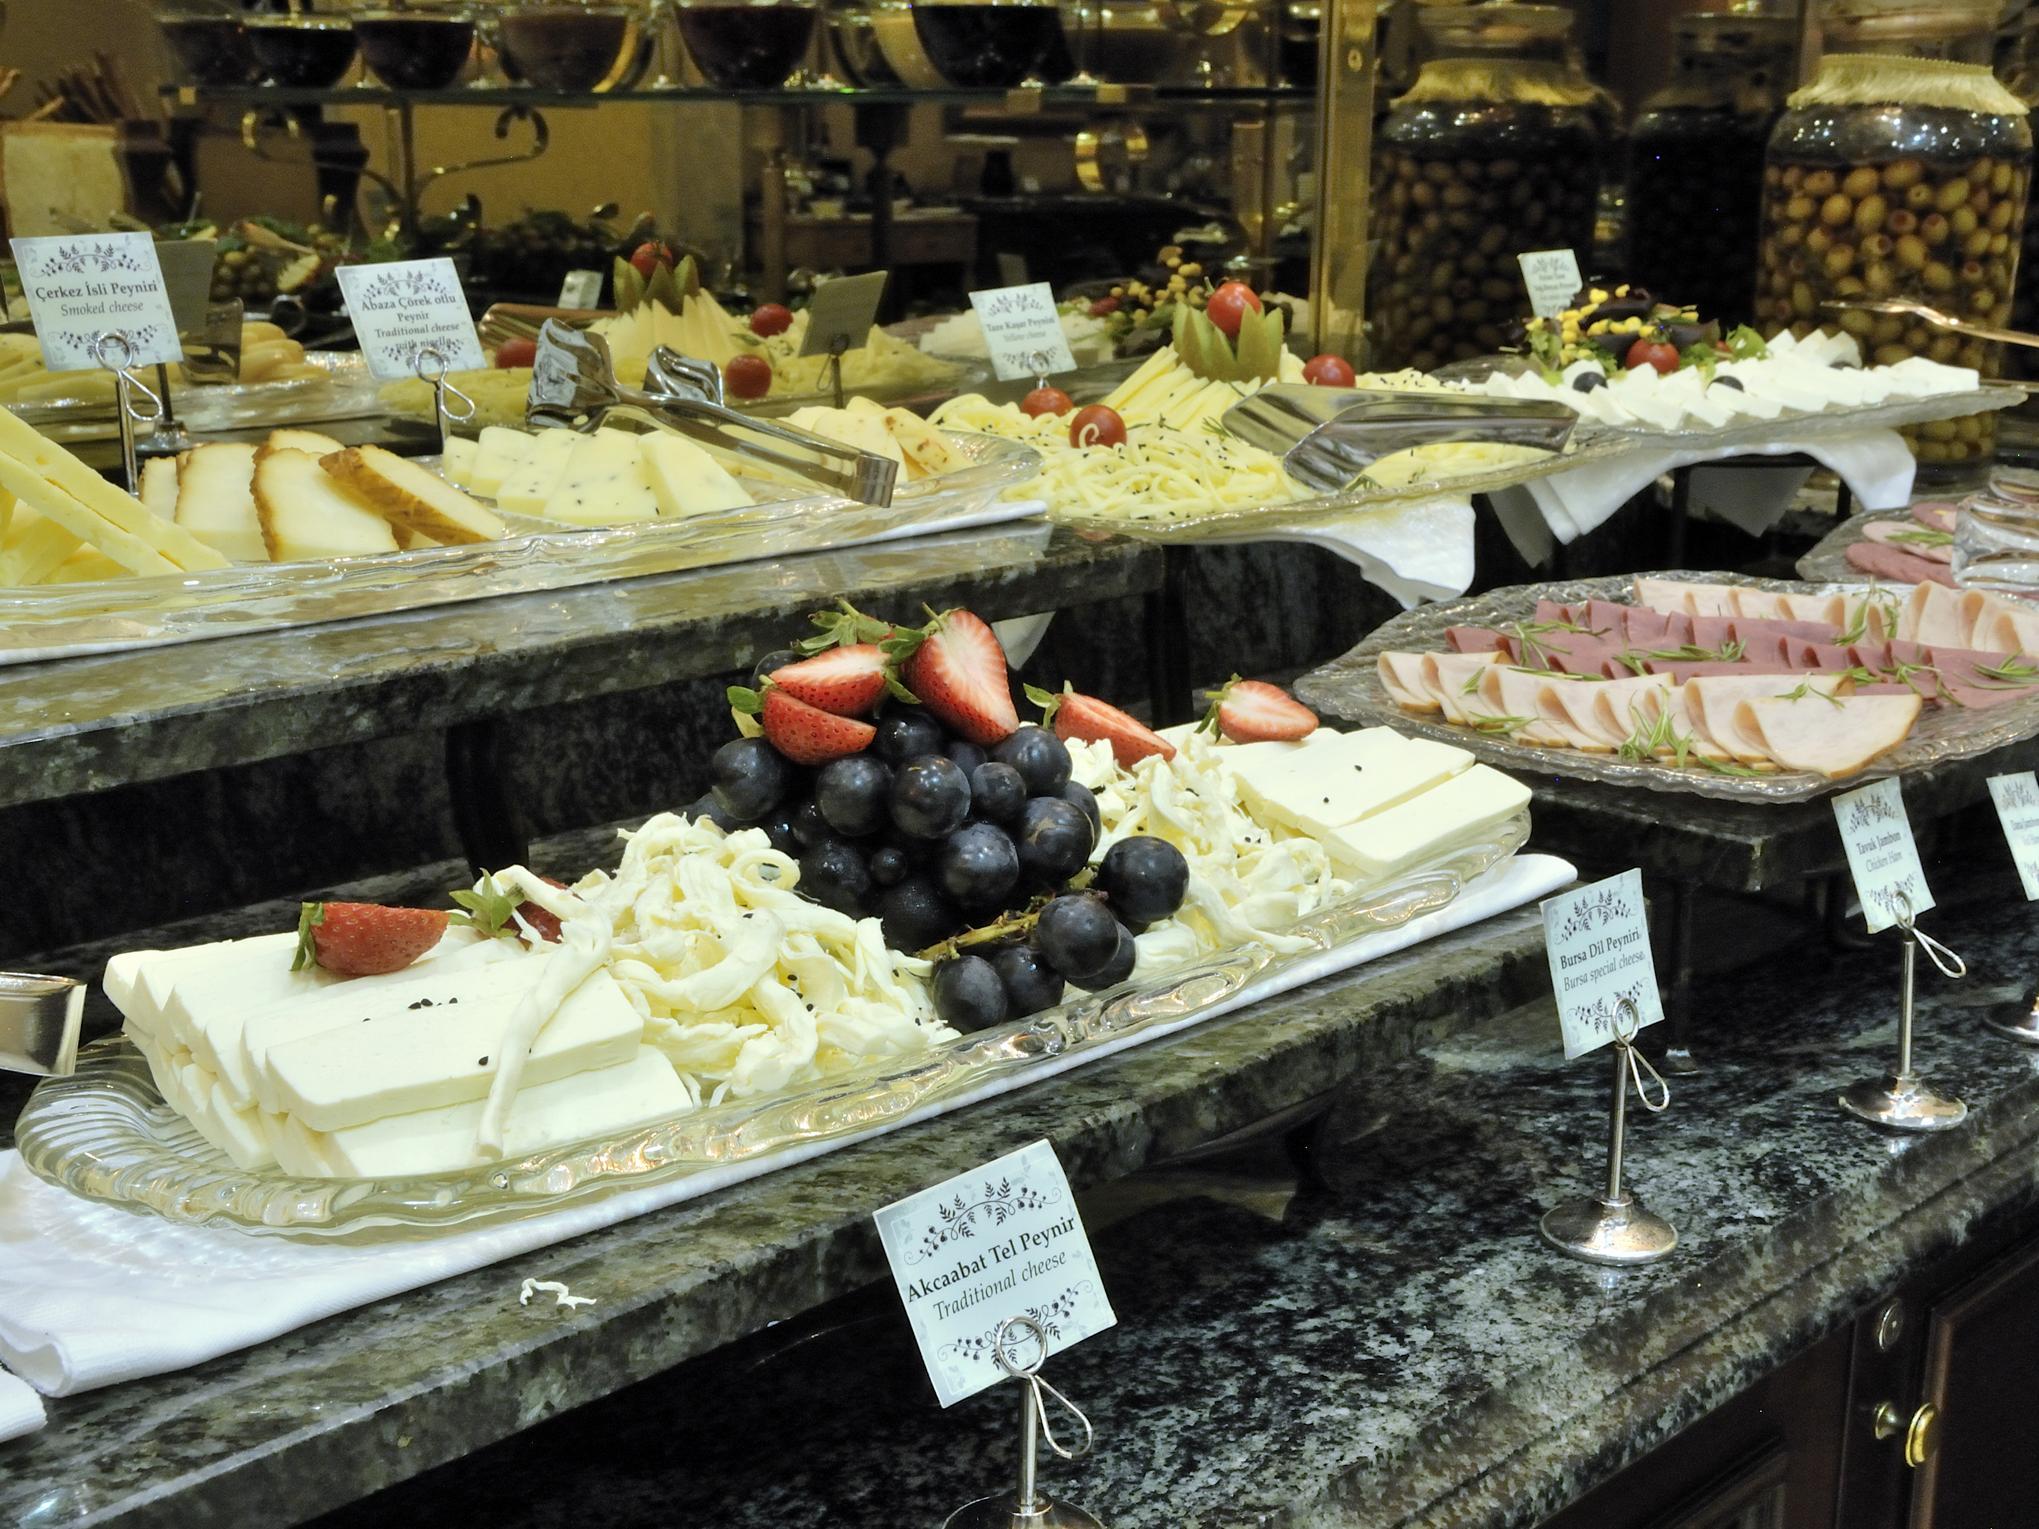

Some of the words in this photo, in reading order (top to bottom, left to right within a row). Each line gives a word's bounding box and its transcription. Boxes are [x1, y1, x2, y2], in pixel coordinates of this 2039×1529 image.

[35, 286, 83, 302] Çerkez
[86, 281, 108, 296] İsli
[111, 280, 158, 297] Peyniri
[60, 301, 105, 317] Smoked
[109, 301, 144, 313] cheese
[361, 299, 396, 311] Abaza
[399, 296, 432, 310] Çörek
[434, 294, 457, 304] otlu
[396, 311, 430, 324] Peynir
[375, 323, 429, 338] Traditional
[431, 321, 460, 333] cheese
[1560, 950, 1587, 970] Bursa
[1589, 942, 1605, 958] Dil
[1606, 926, 1640, 955] Peyniri
[1564, 972, 1588, 992] Bursa
[1590, 957, 1617, 981] special
[1618, 950, 1646, 969] cheese
[907, 1254, 988, 1303] Akcaabat
[988, 1239, 1017, 1265] Tel
[1018, 1216, 1076, 1254] Peynir
[932, 1269, 1017, 1321] Traditional
[1021, 1250, 1067, 1282] cheese
